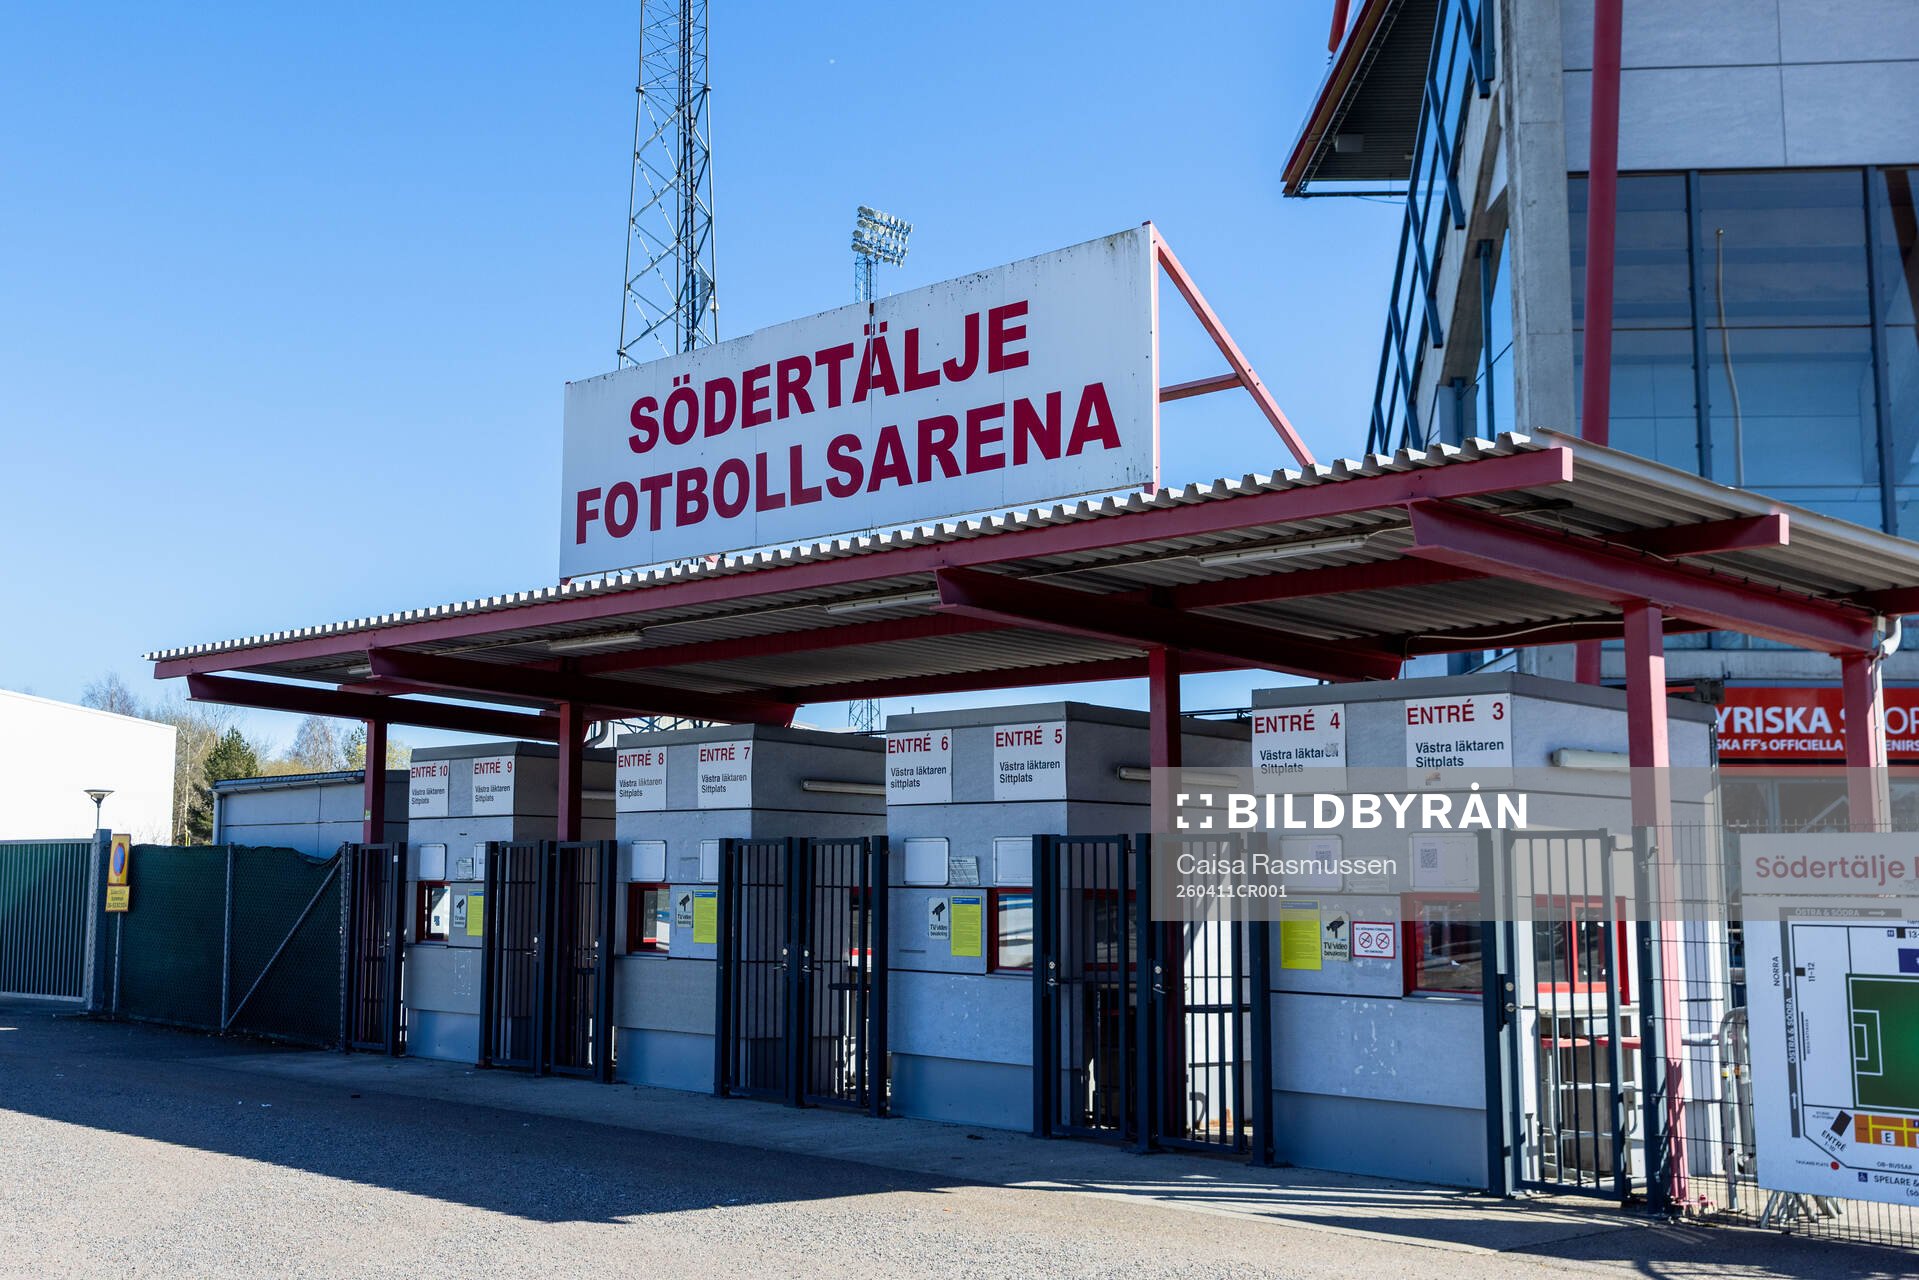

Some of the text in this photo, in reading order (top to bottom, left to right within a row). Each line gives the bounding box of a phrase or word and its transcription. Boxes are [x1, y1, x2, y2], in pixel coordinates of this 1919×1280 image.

[628, 300, 1029, 454] SÖDERTÄLJE
[576, 382, 1122, 545] FOTBOLLSARENA
[1407, 699, 1504, 725] ENTRÉ 3
[1254, 709, 1340, 733] ENTRÉ 4
[887, 733, 949, 754] ENTRÉ 6
[996, 726, 1063, 747] ENTRÉ 5
[1415, 740, 1504, 753] Västra läktaren
[1769, 739, 1843, 751] OFFICIELLA
[618, 750, 664, 768] ENTRÉ 8
[700, 743, 751, 762] ENTRÉ 7
[1260, 749, 1292, 761] Västra
[474, 758, 513, 774] ENTRÉ 9
[1000, 760, 1060, 771] Västra läktaren
[1260, 763, 1304, 776] Sittplats
[1415, 756, 1464, 770] Sittplats
[411, 763, 448, 778] ENTRÉ 10
[890, 766, 947, 777] Västra läktaren
[620, 778, 662, 788] Västra läktaren
[701, 773, 747, 783] Västra läktaren
[999, 773, 1033, 785] Sittplats
[619, 789, 643, 799] Sittplats
[701, 785, 727, 794] Sittplats
[1755, 854, 1905, 886] Södertälje
[1772, 956, 1780, 986] NORRA
[1821, 1129, 1847, 1152] ENTRÉ
[1885, 1132, 1892, 1143] E
[1873, 1175, 1911, 1187] SPELARE
